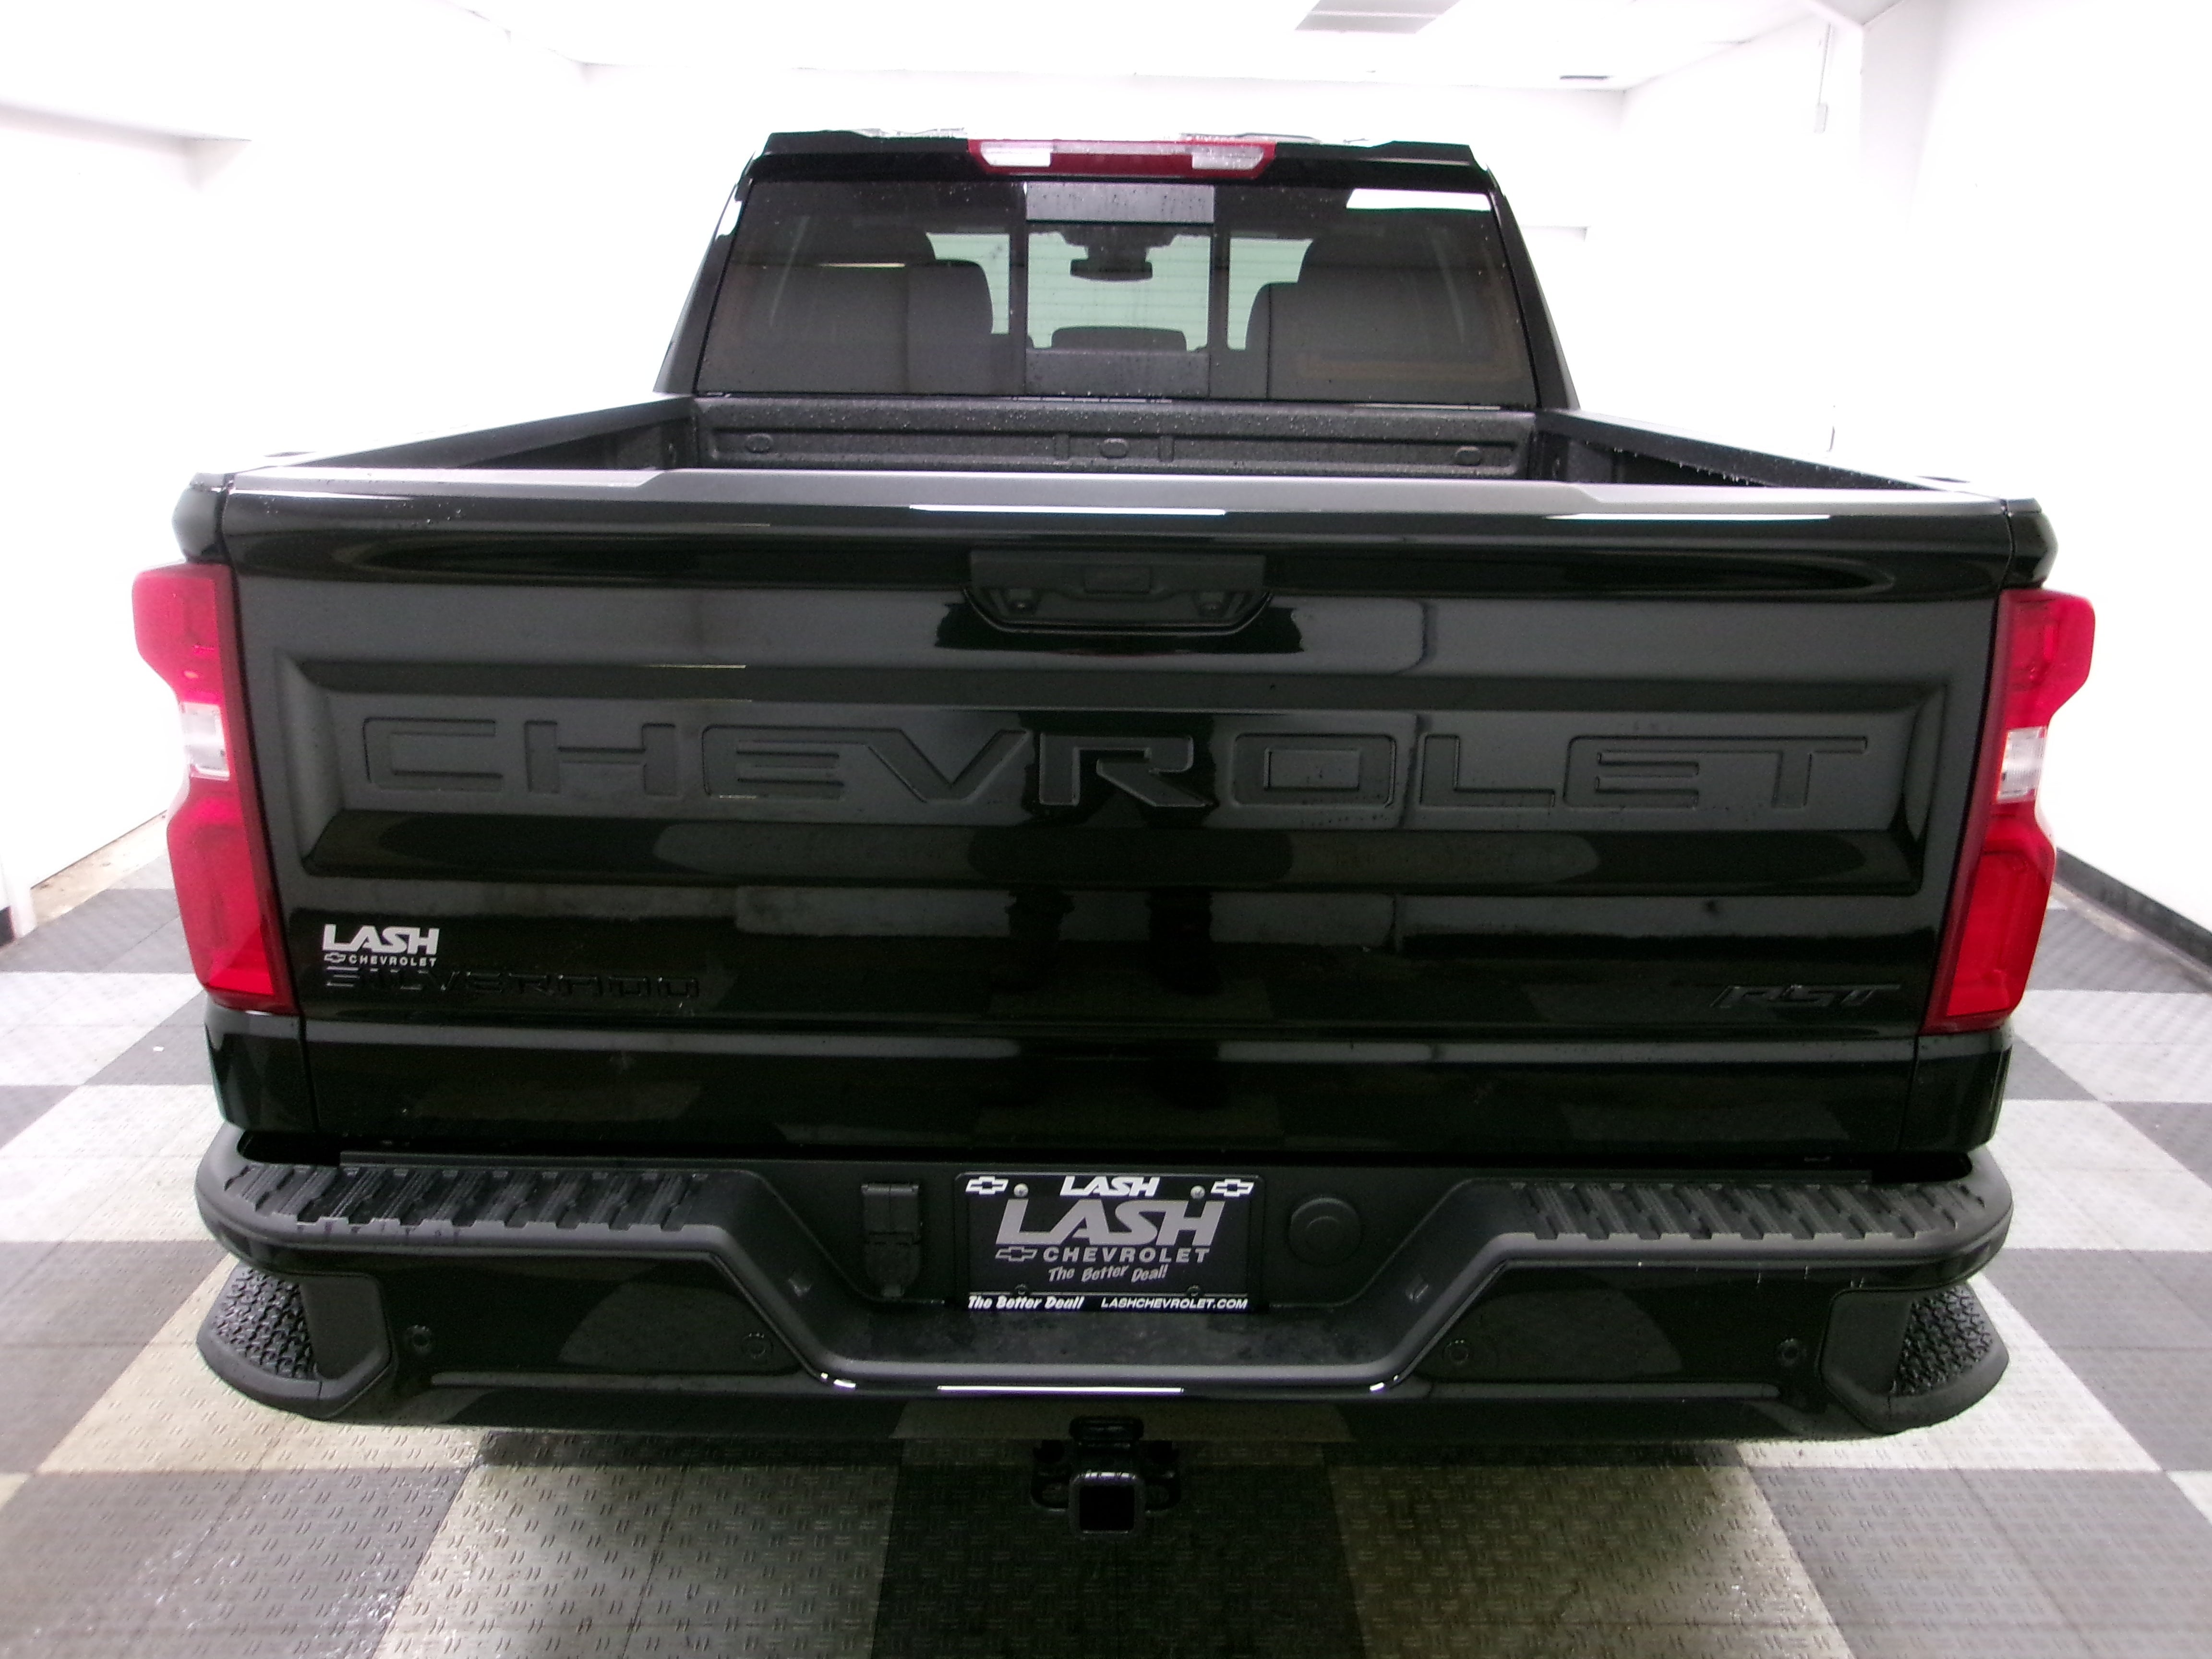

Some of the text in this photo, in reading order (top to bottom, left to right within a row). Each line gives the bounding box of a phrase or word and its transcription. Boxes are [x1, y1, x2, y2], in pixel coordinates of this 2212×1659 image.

[363, 719, 1869, 810] CHEVROLET
[323, 924, 439, 955] LASH
[349, 954, 436, 967] CHEVROLET
[1060, 1176, 1160, 1197] LASH
[996, 1199, 1225, 1247] LASH
[1043, 1247, 1210, 1263] CHEVROLET
[1048, 1264, 1168, 1283] The Better Deal!
[968, 1295, 993, 1310] The
[996, 1295, 1043, 1310] Better
[1101, 1298, 1248, 1310] LASHCHEVROLET.COM
